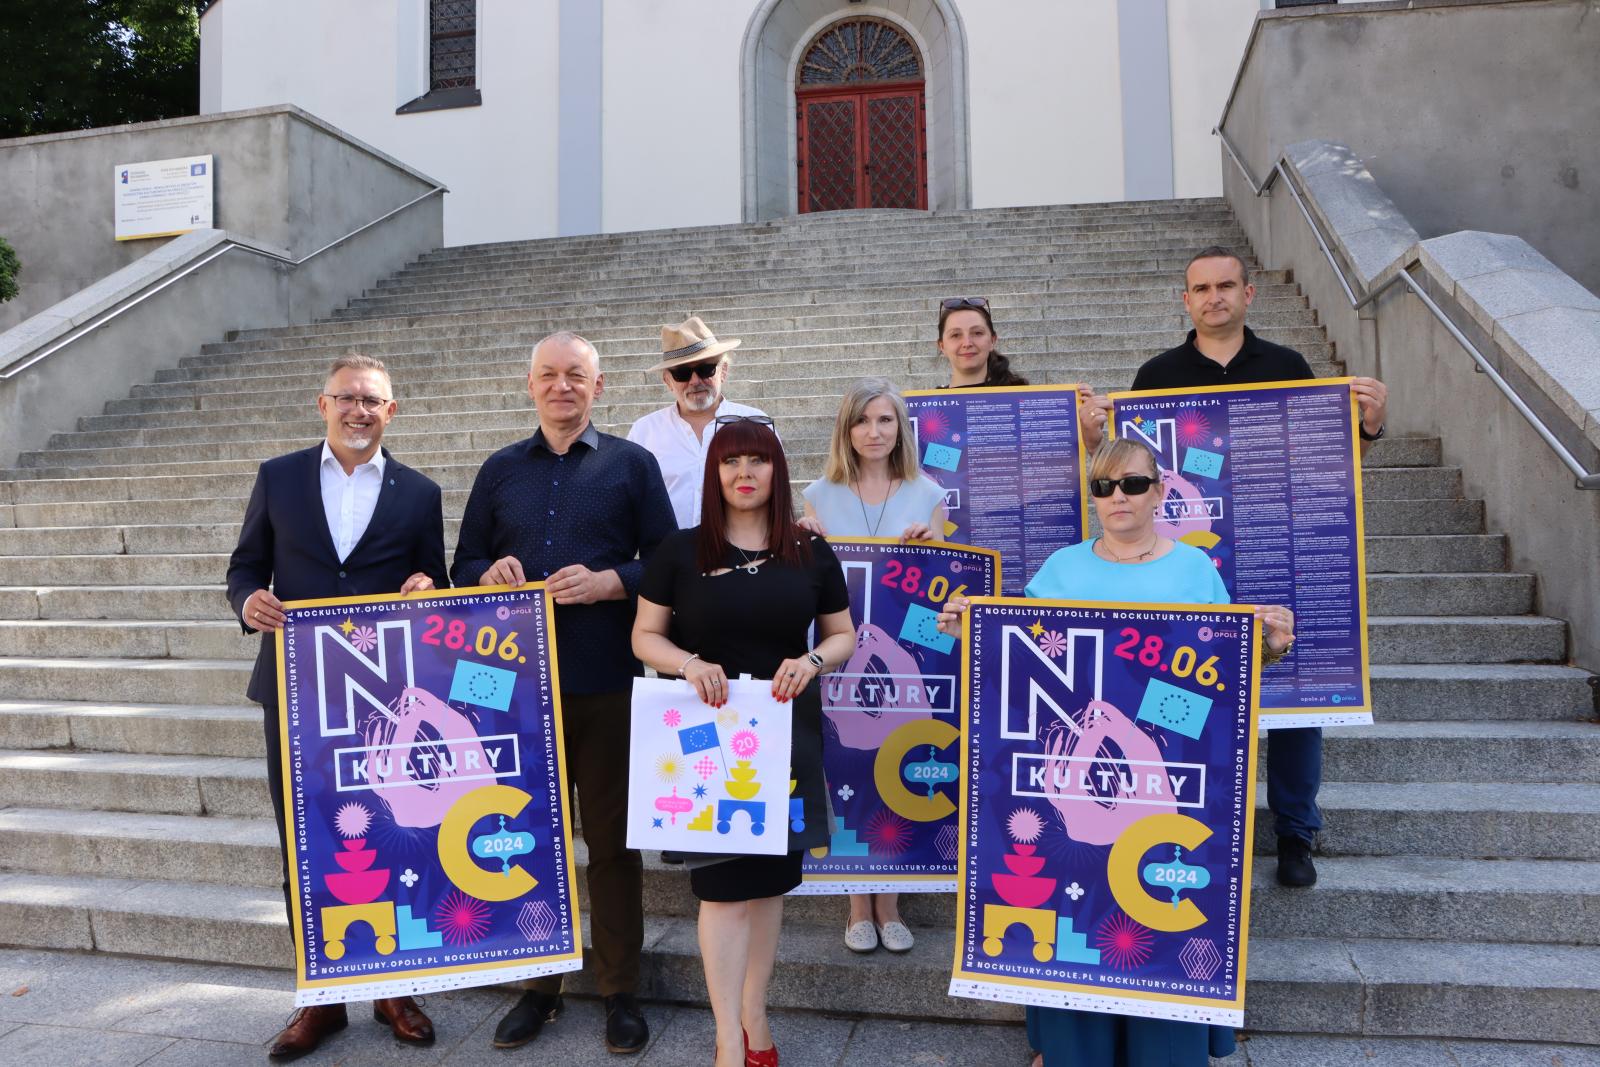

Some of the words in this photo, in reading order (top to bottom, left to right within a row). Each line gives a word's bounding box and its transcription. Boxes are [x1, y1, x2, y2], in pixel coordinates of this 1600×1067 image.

[906, 400, 960, 408] RY.OPOLE.PL
[1121, 399, 1221, 411] NOCKULTURY.OPOLE.PL
[1161, 503, 1214, 516] LTURY
[880, 547, 982, 561] NOCKULTURY.OPOLE.PL
[880, 559, 969, 603] 28.0
[296, 602, 412, 619] NOCKULTURY.OPOLE.PL
[417, 592, 531, 609] NOCKULTURY.OPOLE.PL
[985, 607, 1106, 619] NOCKULTURY.OPOLE.PL
[1112, 611, 1238, 624] NOCKULTURY.OPOLE.PL
[421, 614, 527, 664] 28.06.
[1213, 630, 1238, 639] OPOLE
[287, 611, 300, 726] NOCKULTURY.OPOLE.PL
[973, 607, 983, 725] NOCKULTURY.OPOLE.PL
[1114, 627, 1226, 692] 28.06.
[827, 683, 941, 704] ULTURY
[1236, 616, 1249, 740] NOCKULTURY.OPOLE.PL
[736, 736, 754, 752] 20
[353, 747, 503, 781] KULTURY
[533, 593, 549, 706] NOCKULTURY.OPOLE.PL
[543, 714, 559, 829] NOCKULTURY.OPOLE.PL
[553, 836, 570, 951] NOCKULTURY.OPOLE.PL
[913, 766, 949, 779] 2024
[295, 734, 308, 851] NOCKULTURY.OPOLE.PL
[970, 733, 980, 847] NOCKULTURY.OPOLE.PL
[1029, 766, 1188, 797] KULTURY
[1231, 748, 1244, 868] NOCKULTURY.OPOLE.PL
[483, 836, 524, 853] 2024
[802, 864, 865, 872] URY.OPOLE.PL
[869, 864, 958, 872] NOCKULTURY.OPOLE
[1154, 867, 1198, 884] 2024
[302, 858, 318, 976] NOCKULTURY.OPOLE.PL
[966, 854, 977, 968] NOCKULTURY.OPOLE.PL
[1224, 876, 1238, 996] NOCKULTURY.OPOLE.PL
[321, 957, 438, 975] NOCKULTURY.OPOLE.PL
[444, 943, 560, 963] NOCKULTURY.OPOLE.PL
[977, 961, 1094, 982] NOCKULTURY.OPOLE.PL
[1099, 975, 1222, 995] NOCKULTURY.OPOLE.PL
